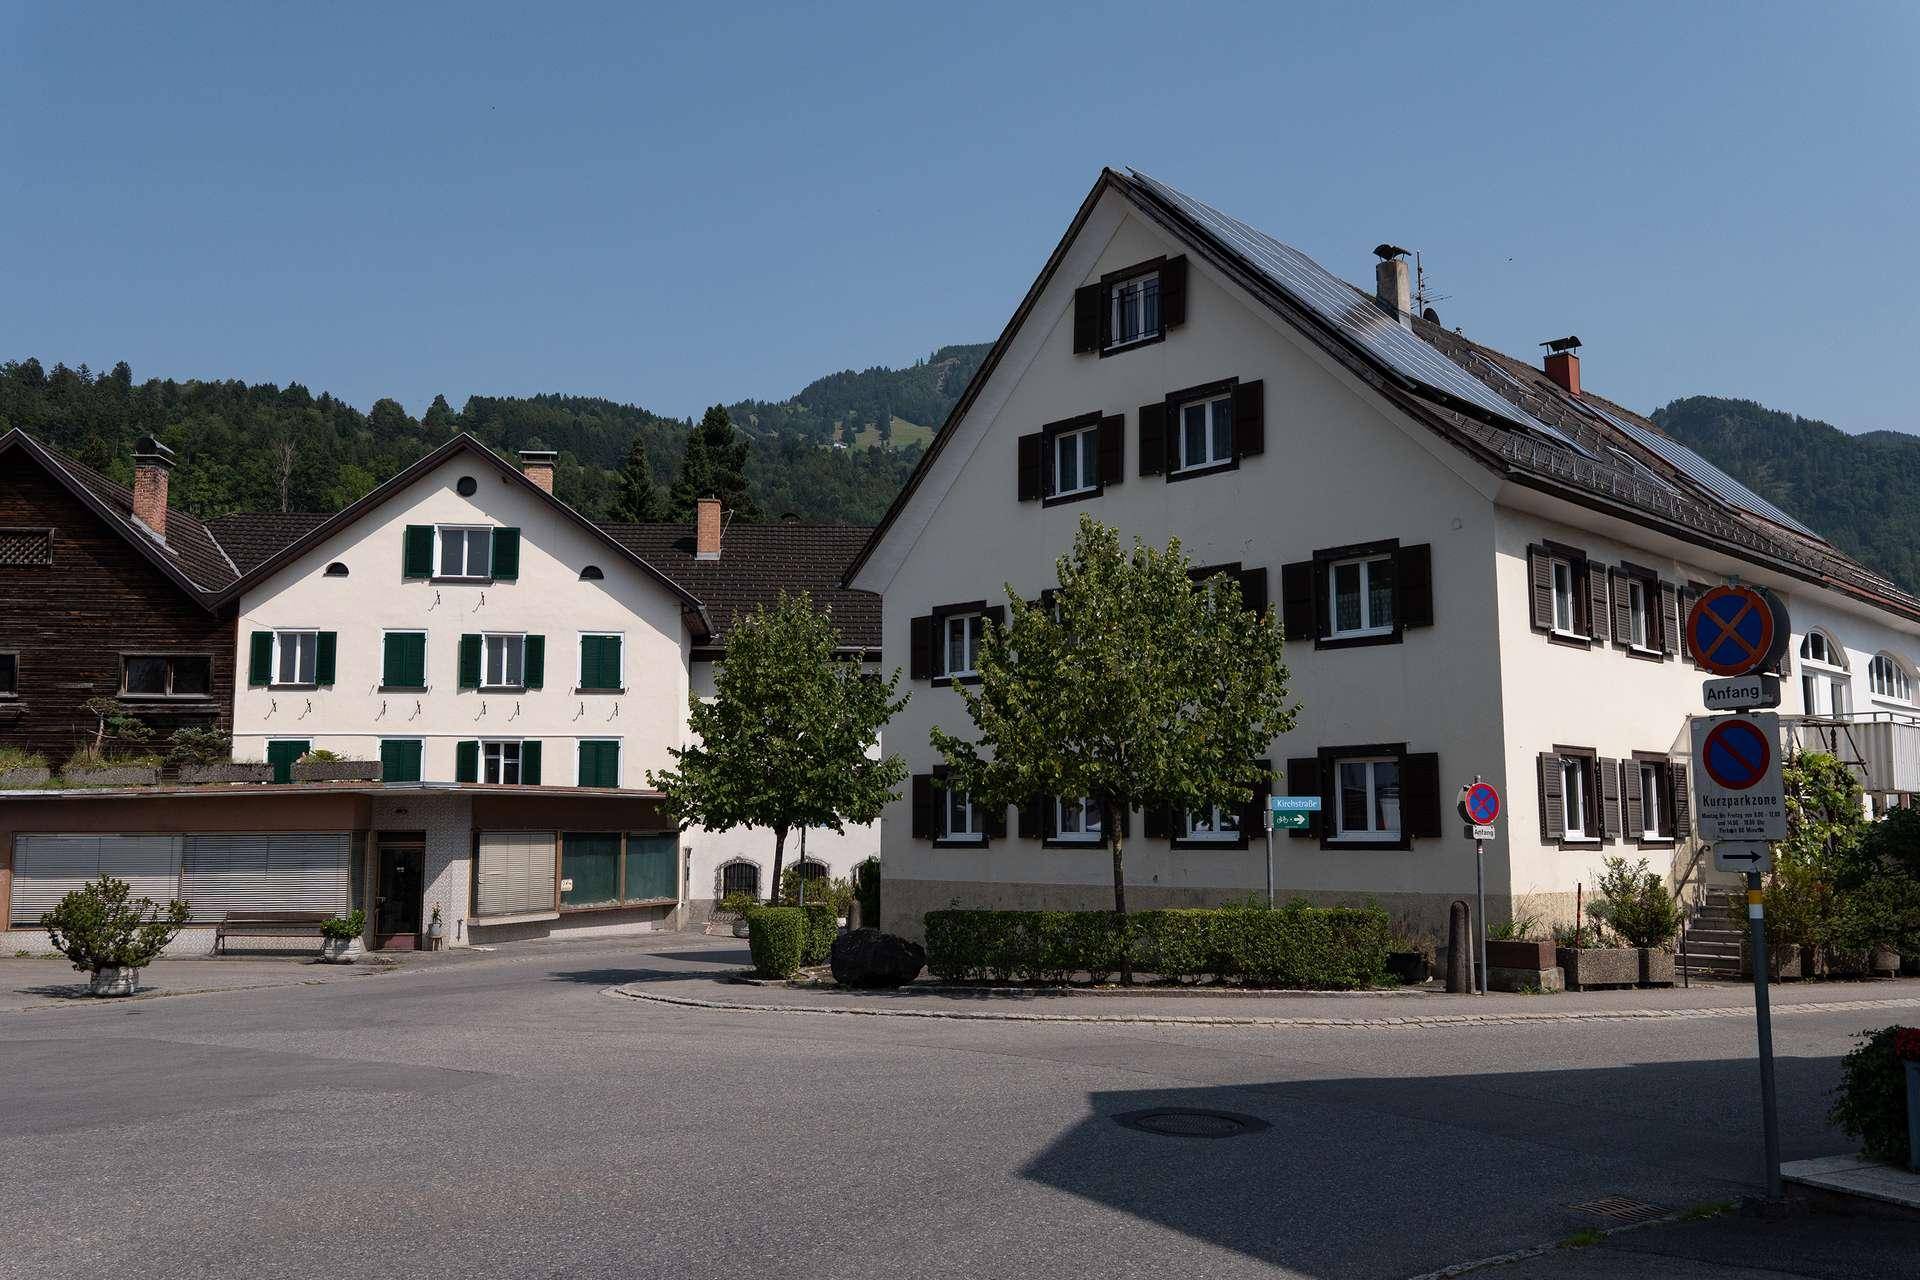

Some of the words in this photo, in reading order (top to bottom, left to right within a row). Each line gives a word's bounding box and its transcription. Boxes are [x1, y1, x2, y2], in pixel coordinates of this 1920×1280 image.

[1707, 686, 1759, 700] Anfang
[1277, 799, 1318, 808] Kirchstraße
[1702, 794, 1777, 809] Kurzparkzone
[1474, 829, 1494, 837] Anfang
